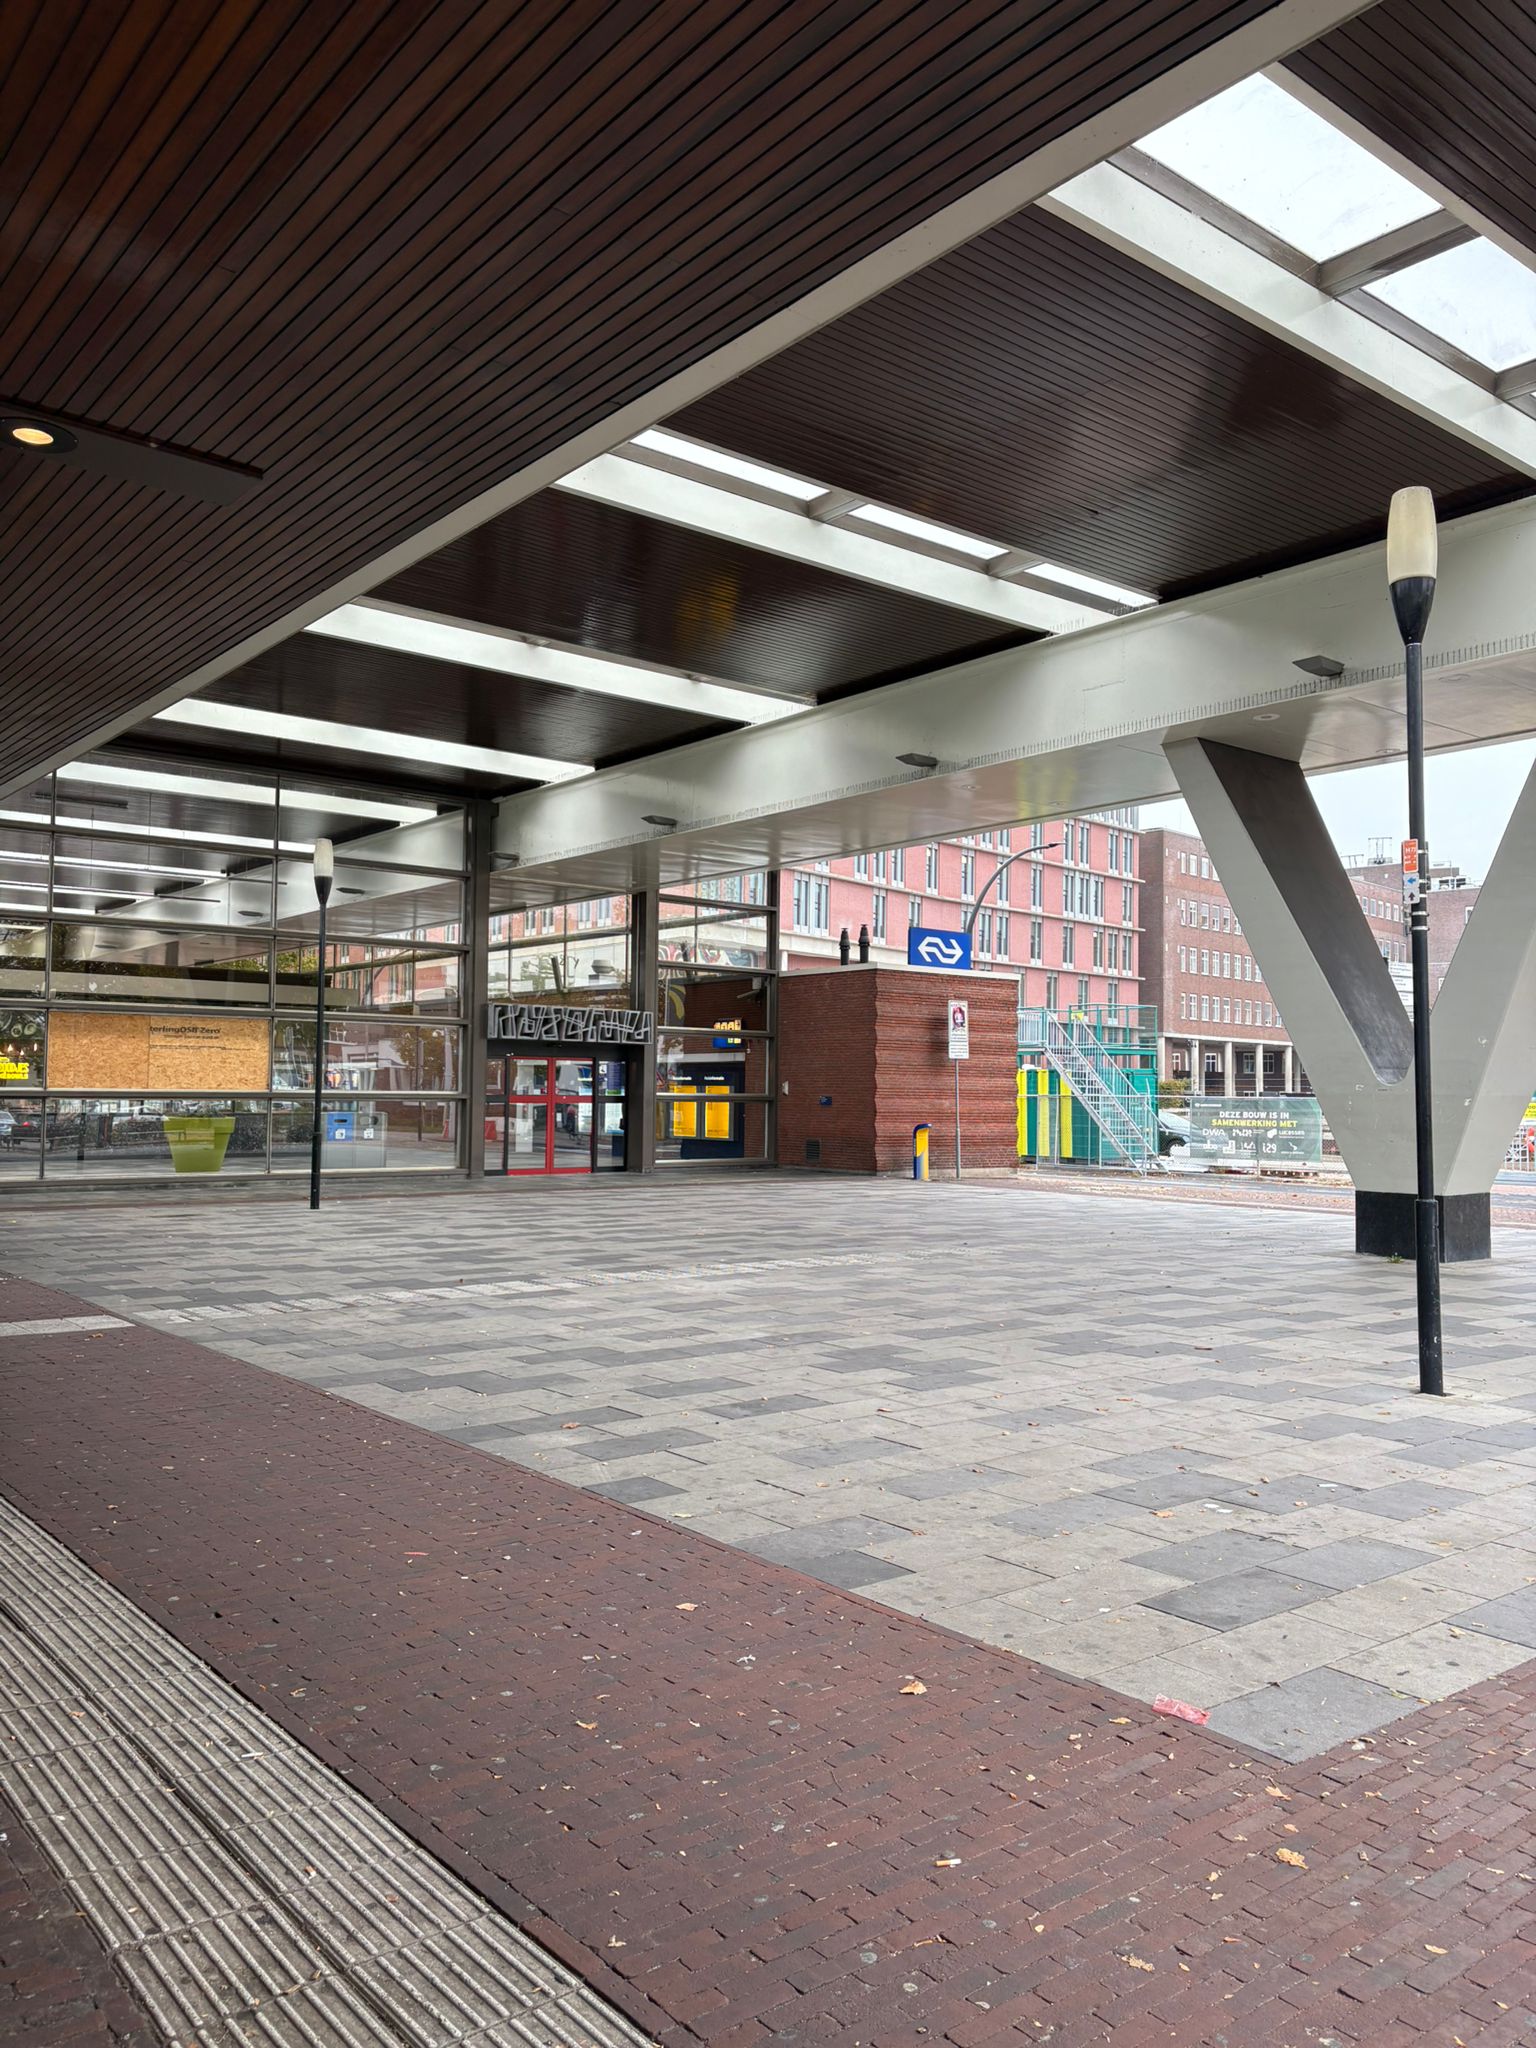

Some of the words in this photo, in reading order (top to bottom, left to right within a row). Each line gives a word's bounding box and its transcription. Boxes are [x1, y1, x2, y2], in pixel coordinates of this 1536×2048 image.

[1269, 1111, 1278, 1119] IS
[1211, 1119, 1278, 1127] SAMENWERKING
[1279, 1120, 1298, 1128] MET
